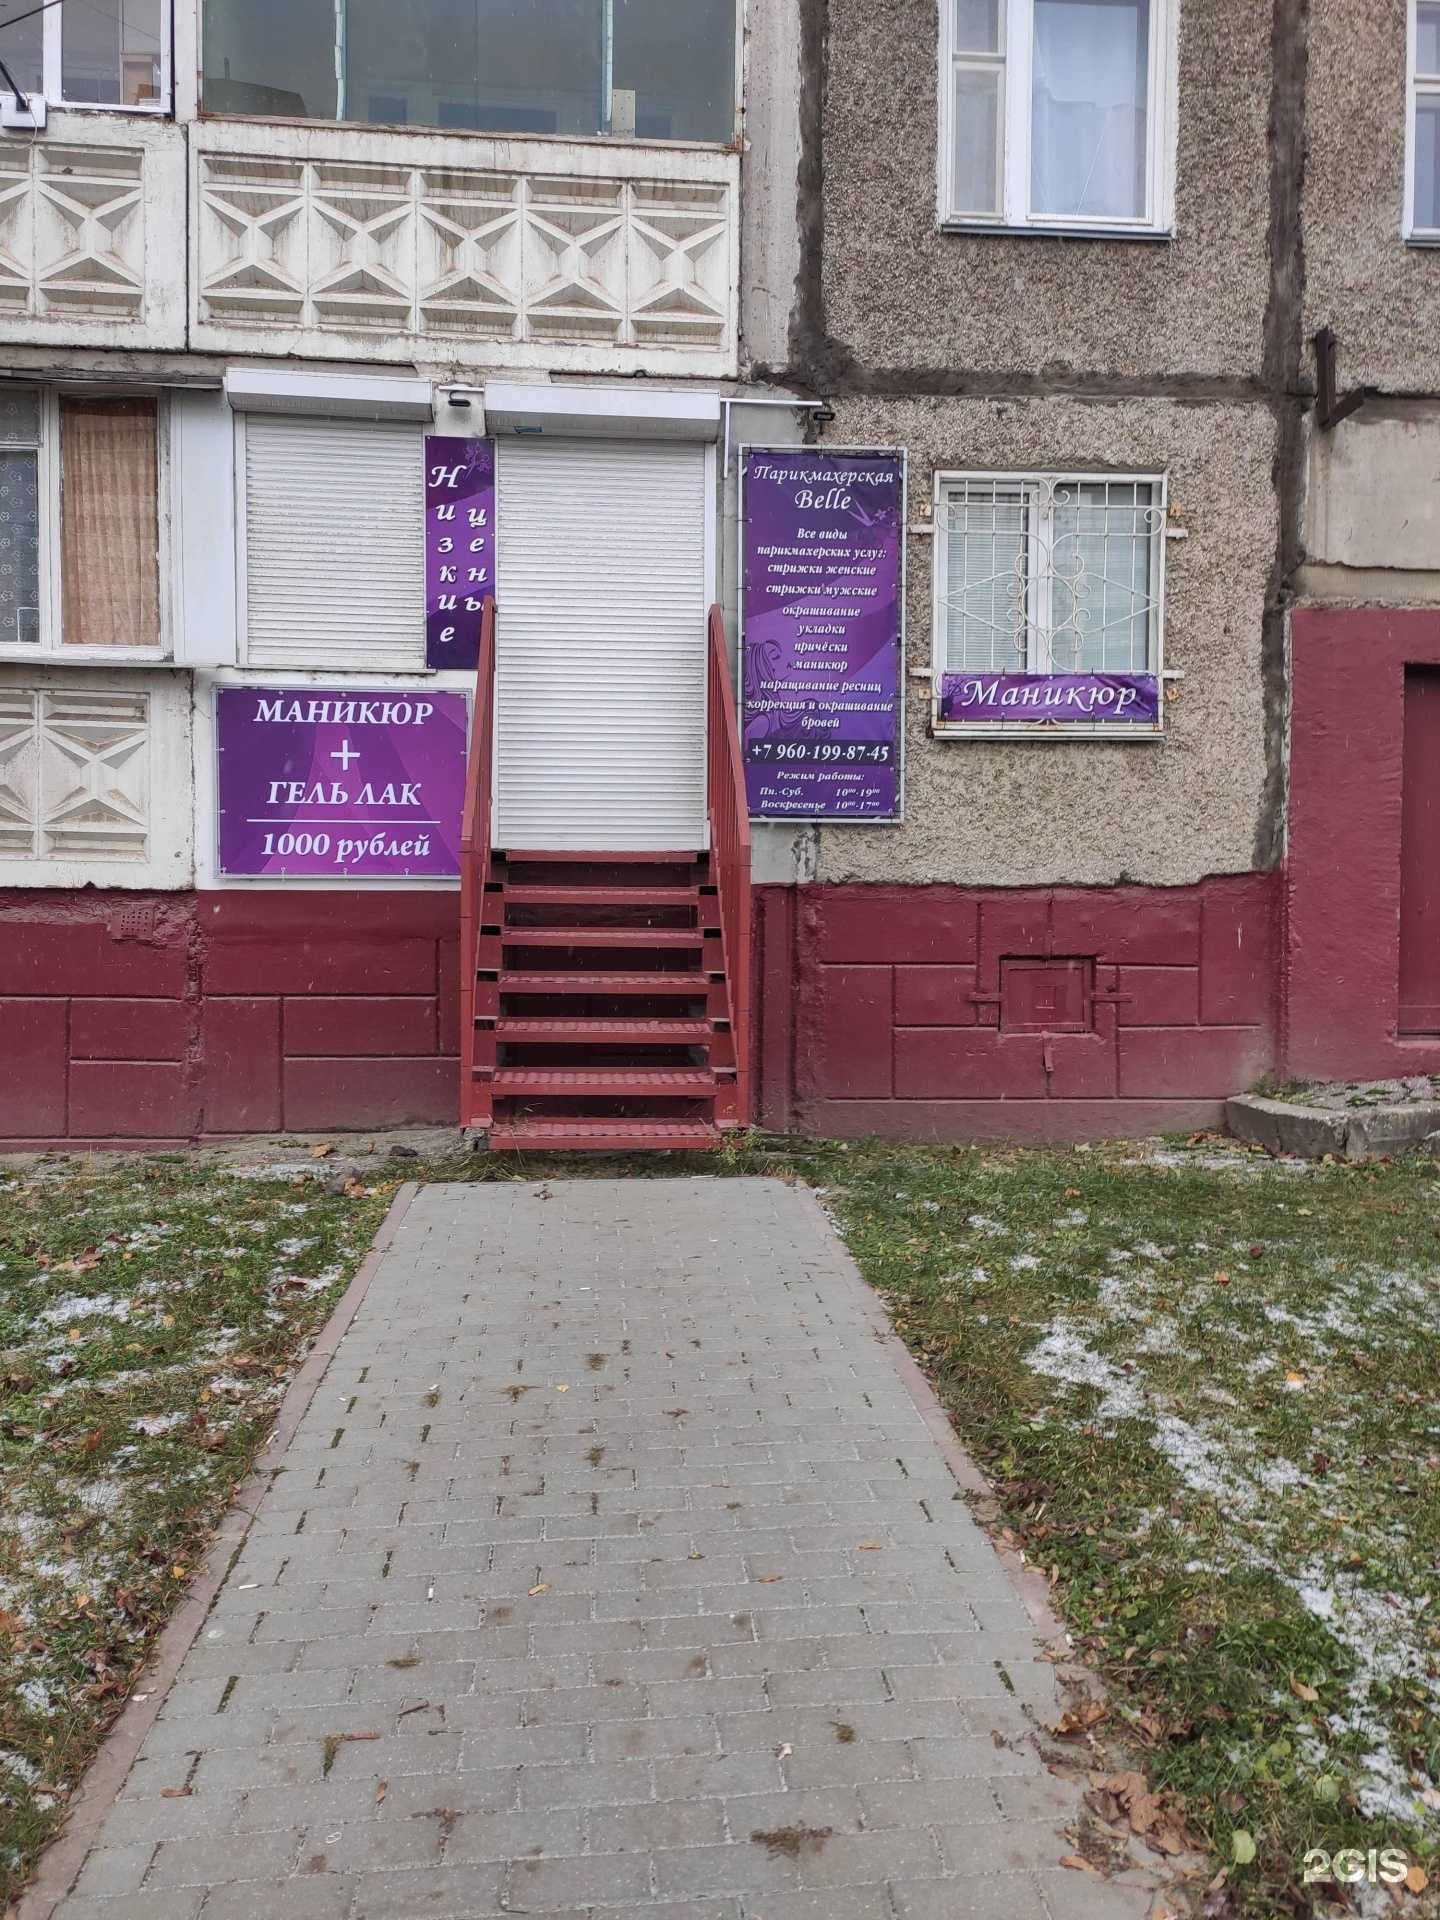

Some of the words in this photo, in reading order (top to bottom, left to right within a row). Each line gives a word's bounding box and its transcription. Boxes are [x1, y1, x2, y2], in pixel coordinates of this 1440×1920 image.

[753, 465, 894, 487] Парикмахерская
[794, 487, 852, 510] Belle
[797, 528, 816, 539] Все
[818, 528, 848, 540] виды
[428, 464, 467, 643] Низкие
[757, 545, 852, 559] парикмахерских
[852, 548, 887, 561] услуг:
[767, 563, 823, 576] стрижки
[825, 565, 877, 576] женские
[766, 583, 821, 597] стрижки
[823, 585, 878, 598] мужские
[782, 606, 861, 618] окрашивание
[796, 624, 846, 636] укладки
[794, 641, 849, 655] причёски
[793, 660, 849, 673] маникюр
[760, 680, 840, 692] наращивание
[841, 682, 882, 694] ресниц
[961, 678, 1137, 716] Маникюр
[253, 699, 434, 725] МАНИКЮР
[747, 700, 806, 712] коррекция
[808, 701, 816, 710] и
[818, 701, 894, 713] окрашивание
[801, 716, 840, 730] бровей
[751, 743, 772, 760] +7
[776, 743, 889, 762] 960-199-87-45
[776, 771, 815, 781] Режим
[817, 771, 865, 783] работы:
[266, 780, 349, 805] ГЕЛЬ
[353, 782, 422, 806] ЛАК
[761, 800, 826, 810] Воскресенье
[261, 832, 331, 856] 1000
[333, 831, 431, 864] рублей
